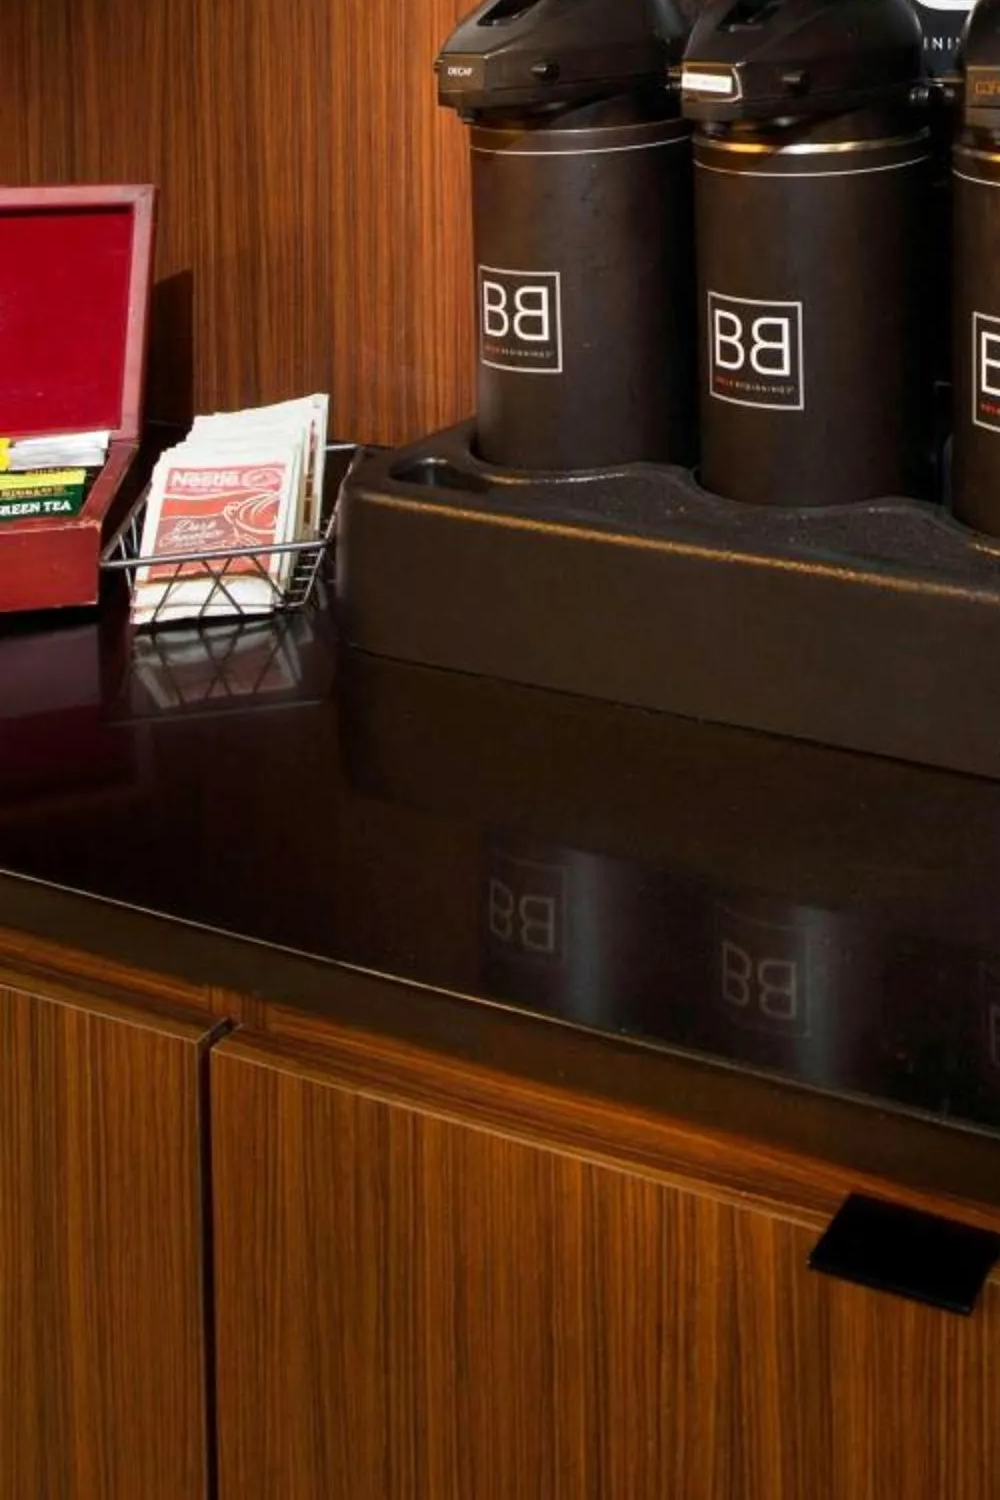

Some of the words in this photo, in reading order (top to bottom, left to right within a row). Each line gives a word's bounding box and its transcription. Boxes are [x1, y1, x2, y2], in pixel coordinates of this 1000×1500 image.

[483, 280, 549, 341] BB
[714, 308, 790, 377] BB
[0, 501, 41, 516] REEN
[43, 500, 72, 512] TEA
